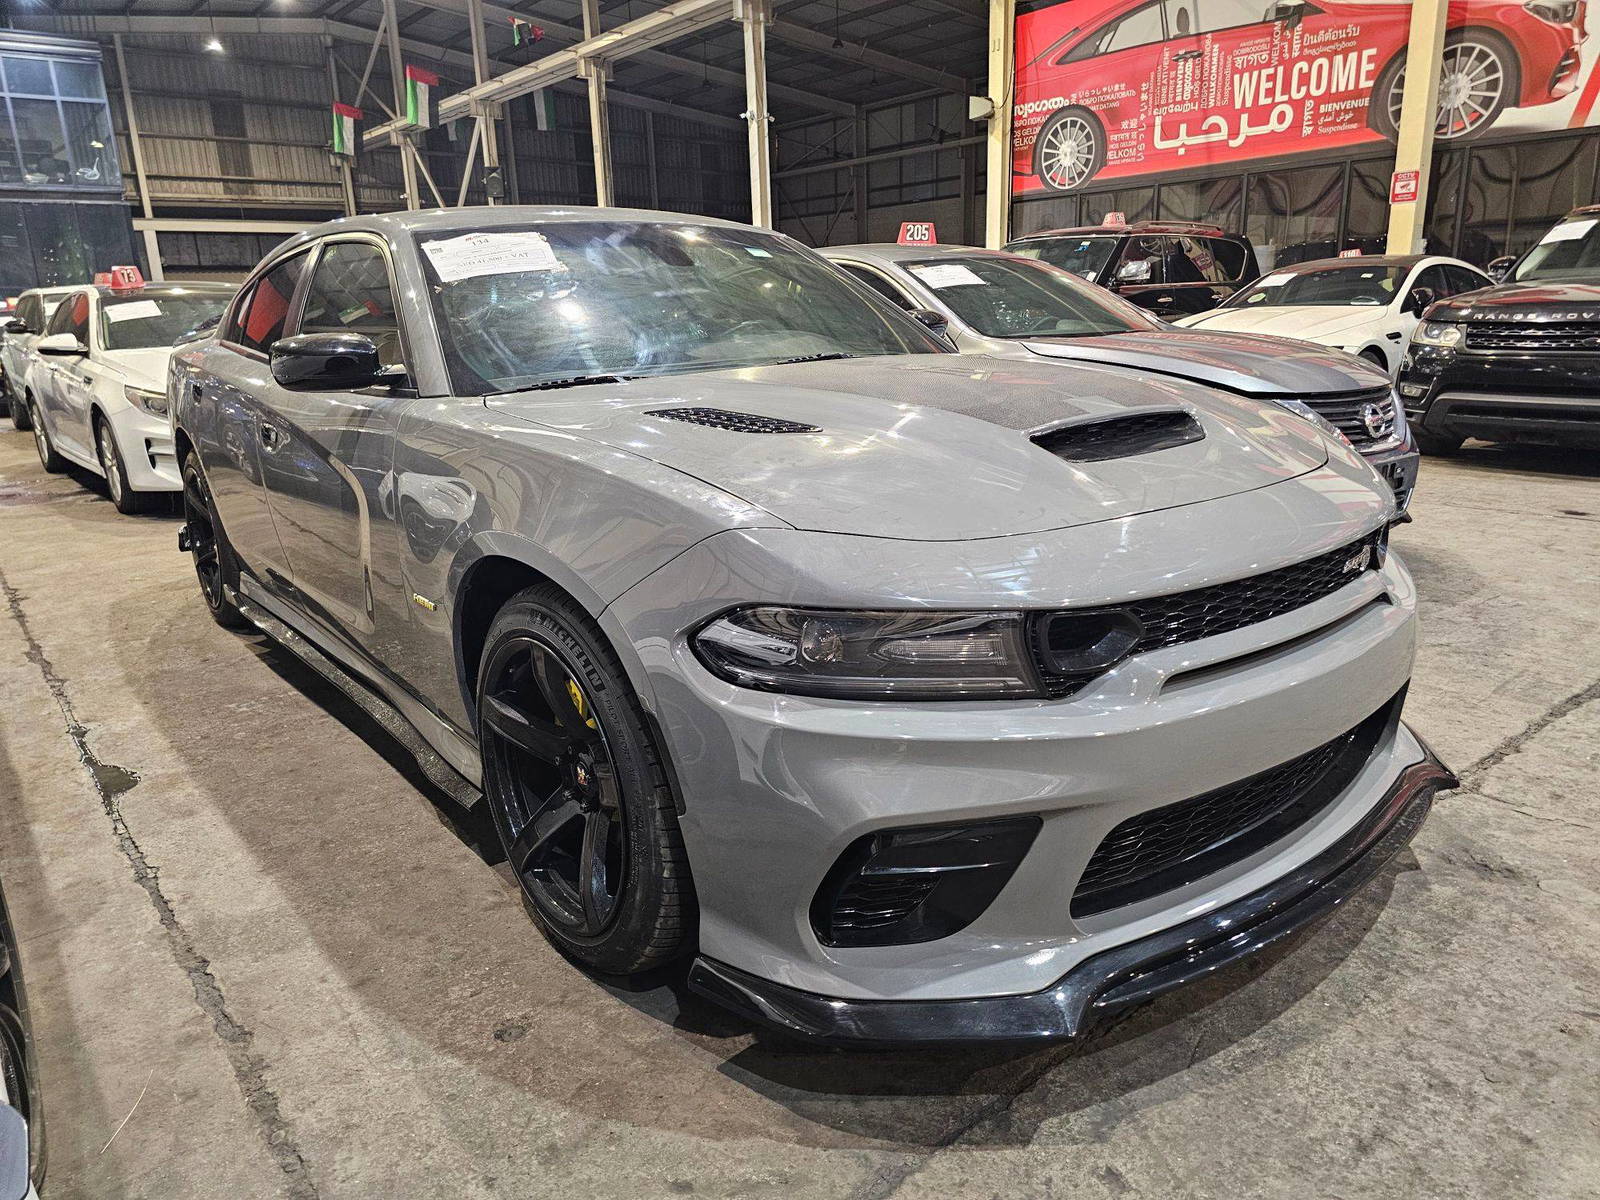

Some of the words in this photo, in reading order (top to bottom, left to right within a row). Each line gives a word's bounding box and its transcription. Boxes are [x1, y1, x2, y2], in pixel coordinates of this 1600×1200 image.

[1271, 21, 1282, 67] WELKOM
[1208, 44, 1219, 108] WILLKOMMEN
[1234, 48, 1377, 110] WELCOME
[1153, 103, 1294, 155] مرحبا
[1319, 98, 1370, 114] BIENVENUE
[1014, 135, 1036, 147] ELKO
[906, 224, 928, 240] 205
[543, 618, 602, 690] MICHELIN
